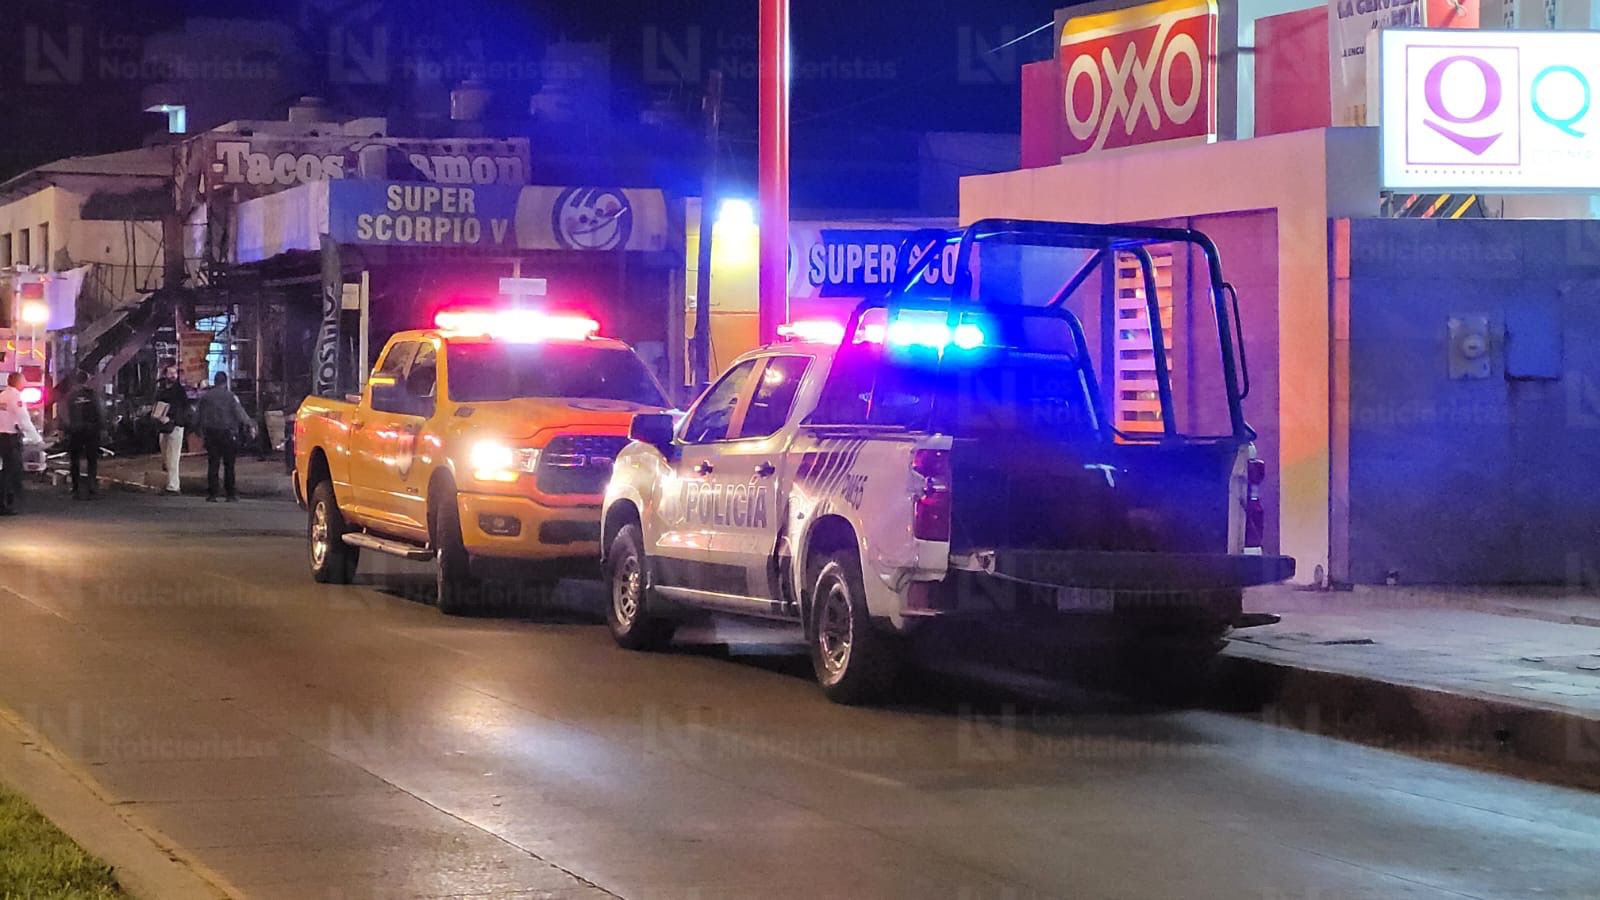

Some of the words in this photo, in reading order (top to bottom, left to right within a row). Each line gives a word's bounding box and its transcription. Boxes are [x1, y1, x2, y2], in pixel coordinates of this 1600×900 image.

[1065, 26, 1202, 150] OXXO
[1530, 64, 1592, 138] Q
[215, 141, 345, 185] Tacos
[387, 184, 476, 213] SUPER
[357, 214, 481, 242] SCORPIO
[491, 218, 509, 244] V
[810, 243, 897, 285] SUPER
[686, 475, 768, 529] POLICÍA
